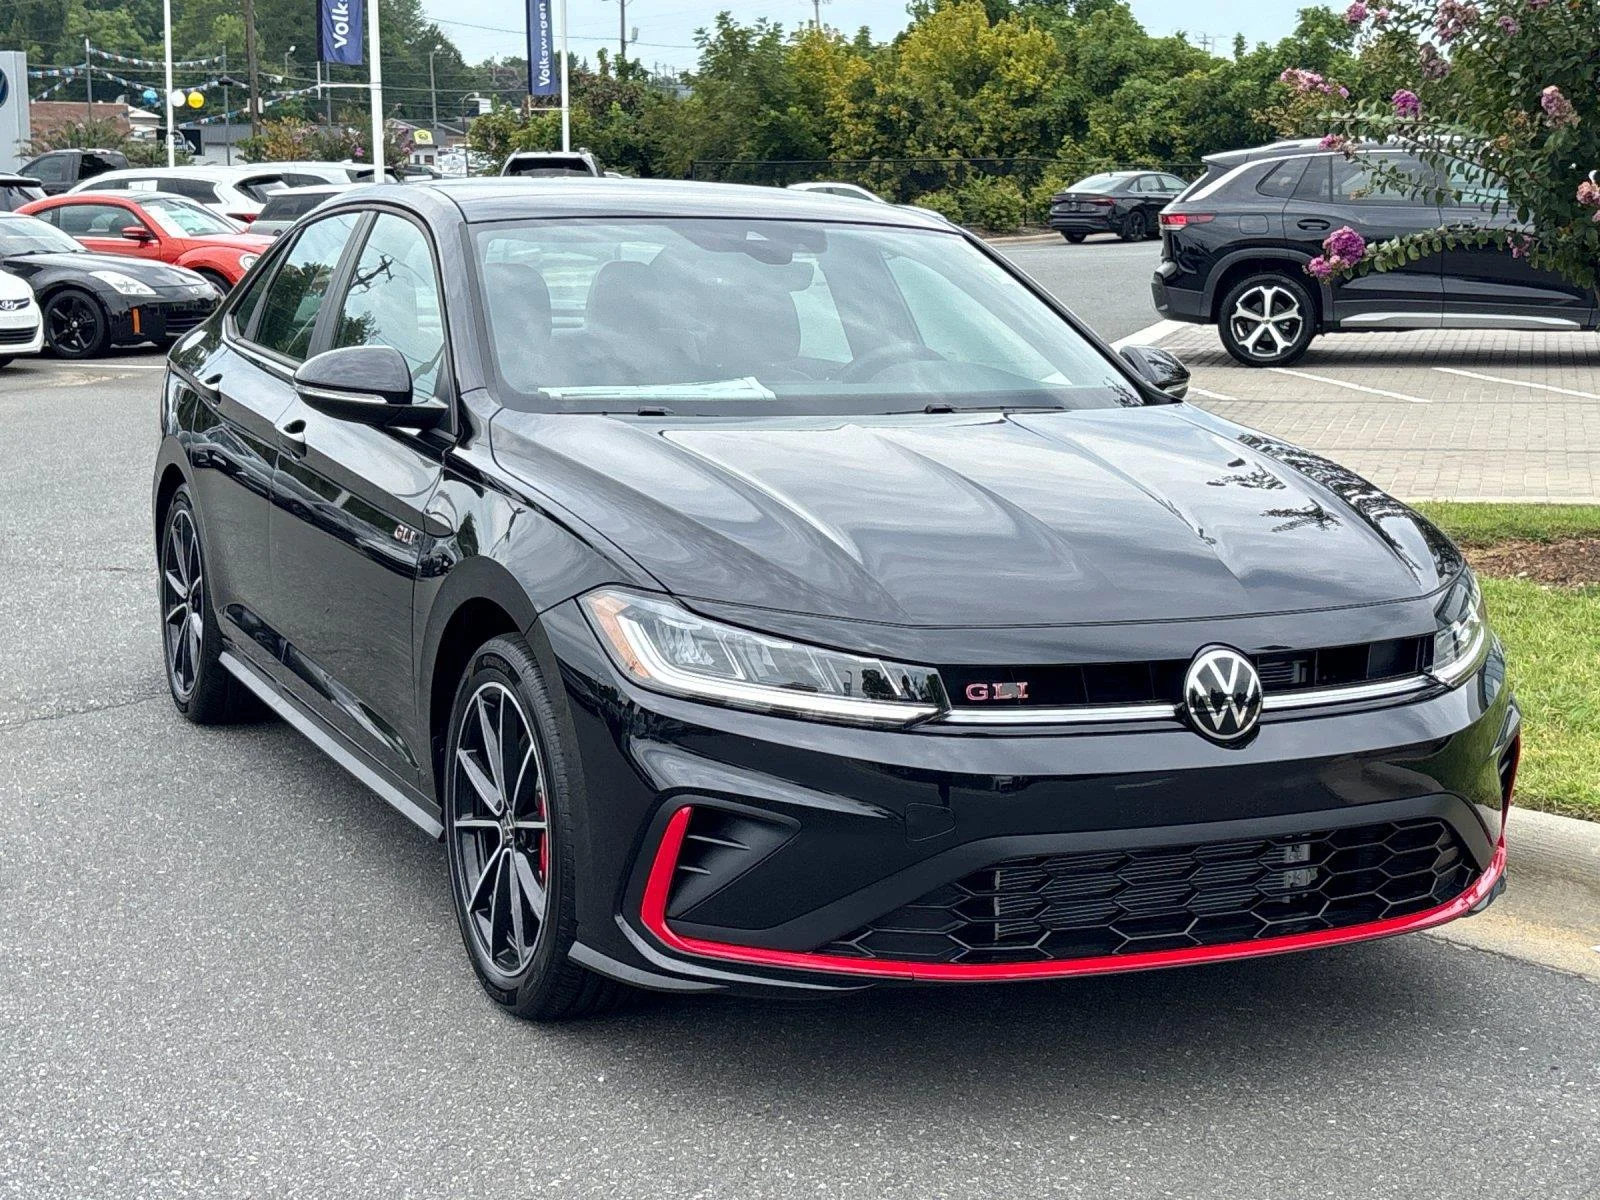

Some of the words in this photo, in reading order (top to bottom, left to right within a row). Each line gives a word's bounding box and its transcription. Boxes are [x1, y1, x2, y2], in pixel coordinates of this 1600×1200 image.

[538, 3, 551, 87] Volkswagen
[394, 525, 415, 546] GLI
[966, 682, 1029, 701] GLI
